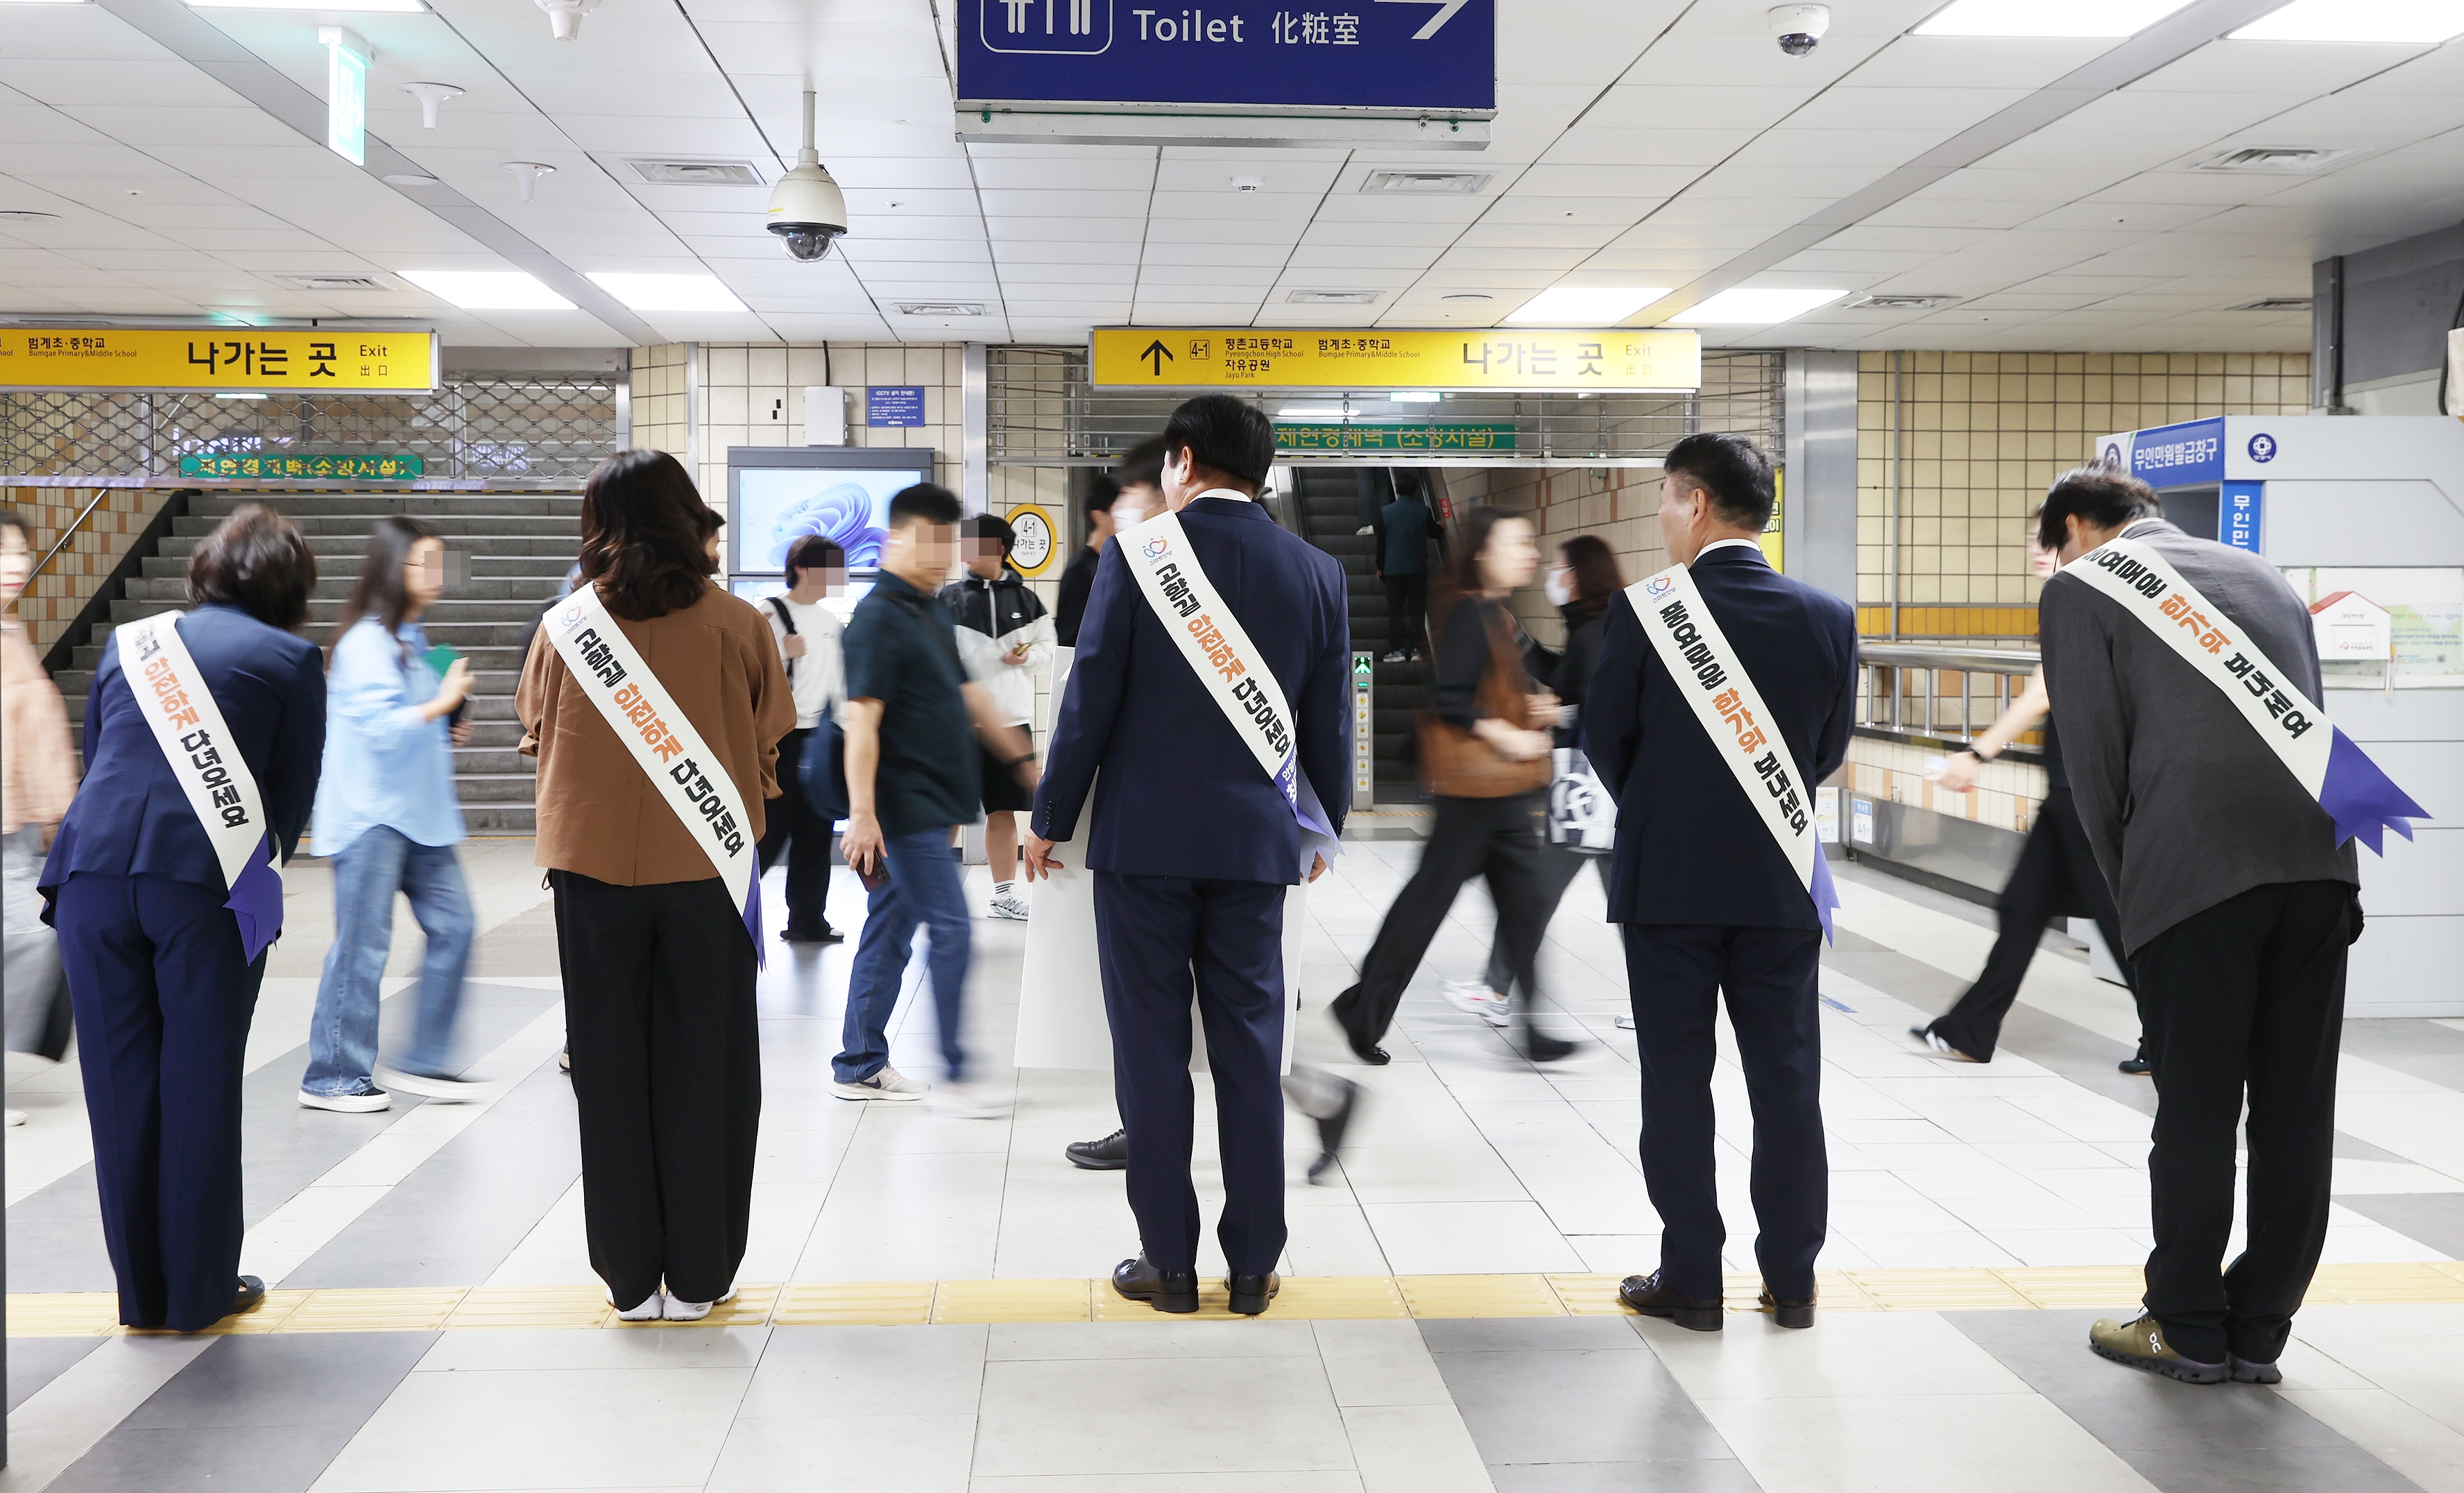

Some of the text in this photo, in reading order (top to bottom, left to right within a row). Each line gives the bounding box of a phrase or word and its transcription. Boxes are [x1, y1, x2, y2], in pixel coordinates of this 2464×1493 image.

[1133, 10, 1244, 43] Toilet
[1271, 11, 1360, 45] 化粧室
[28, 337, 105, 350] 범계초·중학교
[360, 344, 388, 357] Exit
[1191, 342, 1208, 357] 4-1
[1225, 338, 1293, 350] 평촌고등학교
[1319, 339, 1391, 350] 범계초·중학교
[1625, 344, 1652, 356] Exit
[58, 350, 113, 358] Primary&Middle
[188, 341, 337, 377] 나가는 곳
[1463, 343, 1603, 375] 나가는 곳
[360, 365, 388, 377] 出口
[1225, 359, 1270, 371] 자유공원
[1626, 364, 1652, 375] 出口
[2134, 438, 2218, 470] 무인민원발급창구
[1023, 520, 1035, 536] 4-1
[2232, 495, 2250, 548] 무인민
[1039, 539, 1045, 549] 곳
[1155, 563, 1291, 758] 고향길 안전하게 다녀오세요
[2158, 593, 2232, 654] 한가위
[2223, 652, 2313, 740] 보내세요
[1659, 599, 1809, 837] 풍요로운 한가위 보내세요
[144, 657, 201, 731] 안전하게
[180, 729, 250, 829] 다녀오세요
[574, 628, 745, 858] 고향길 안전하게 다녀오세요
